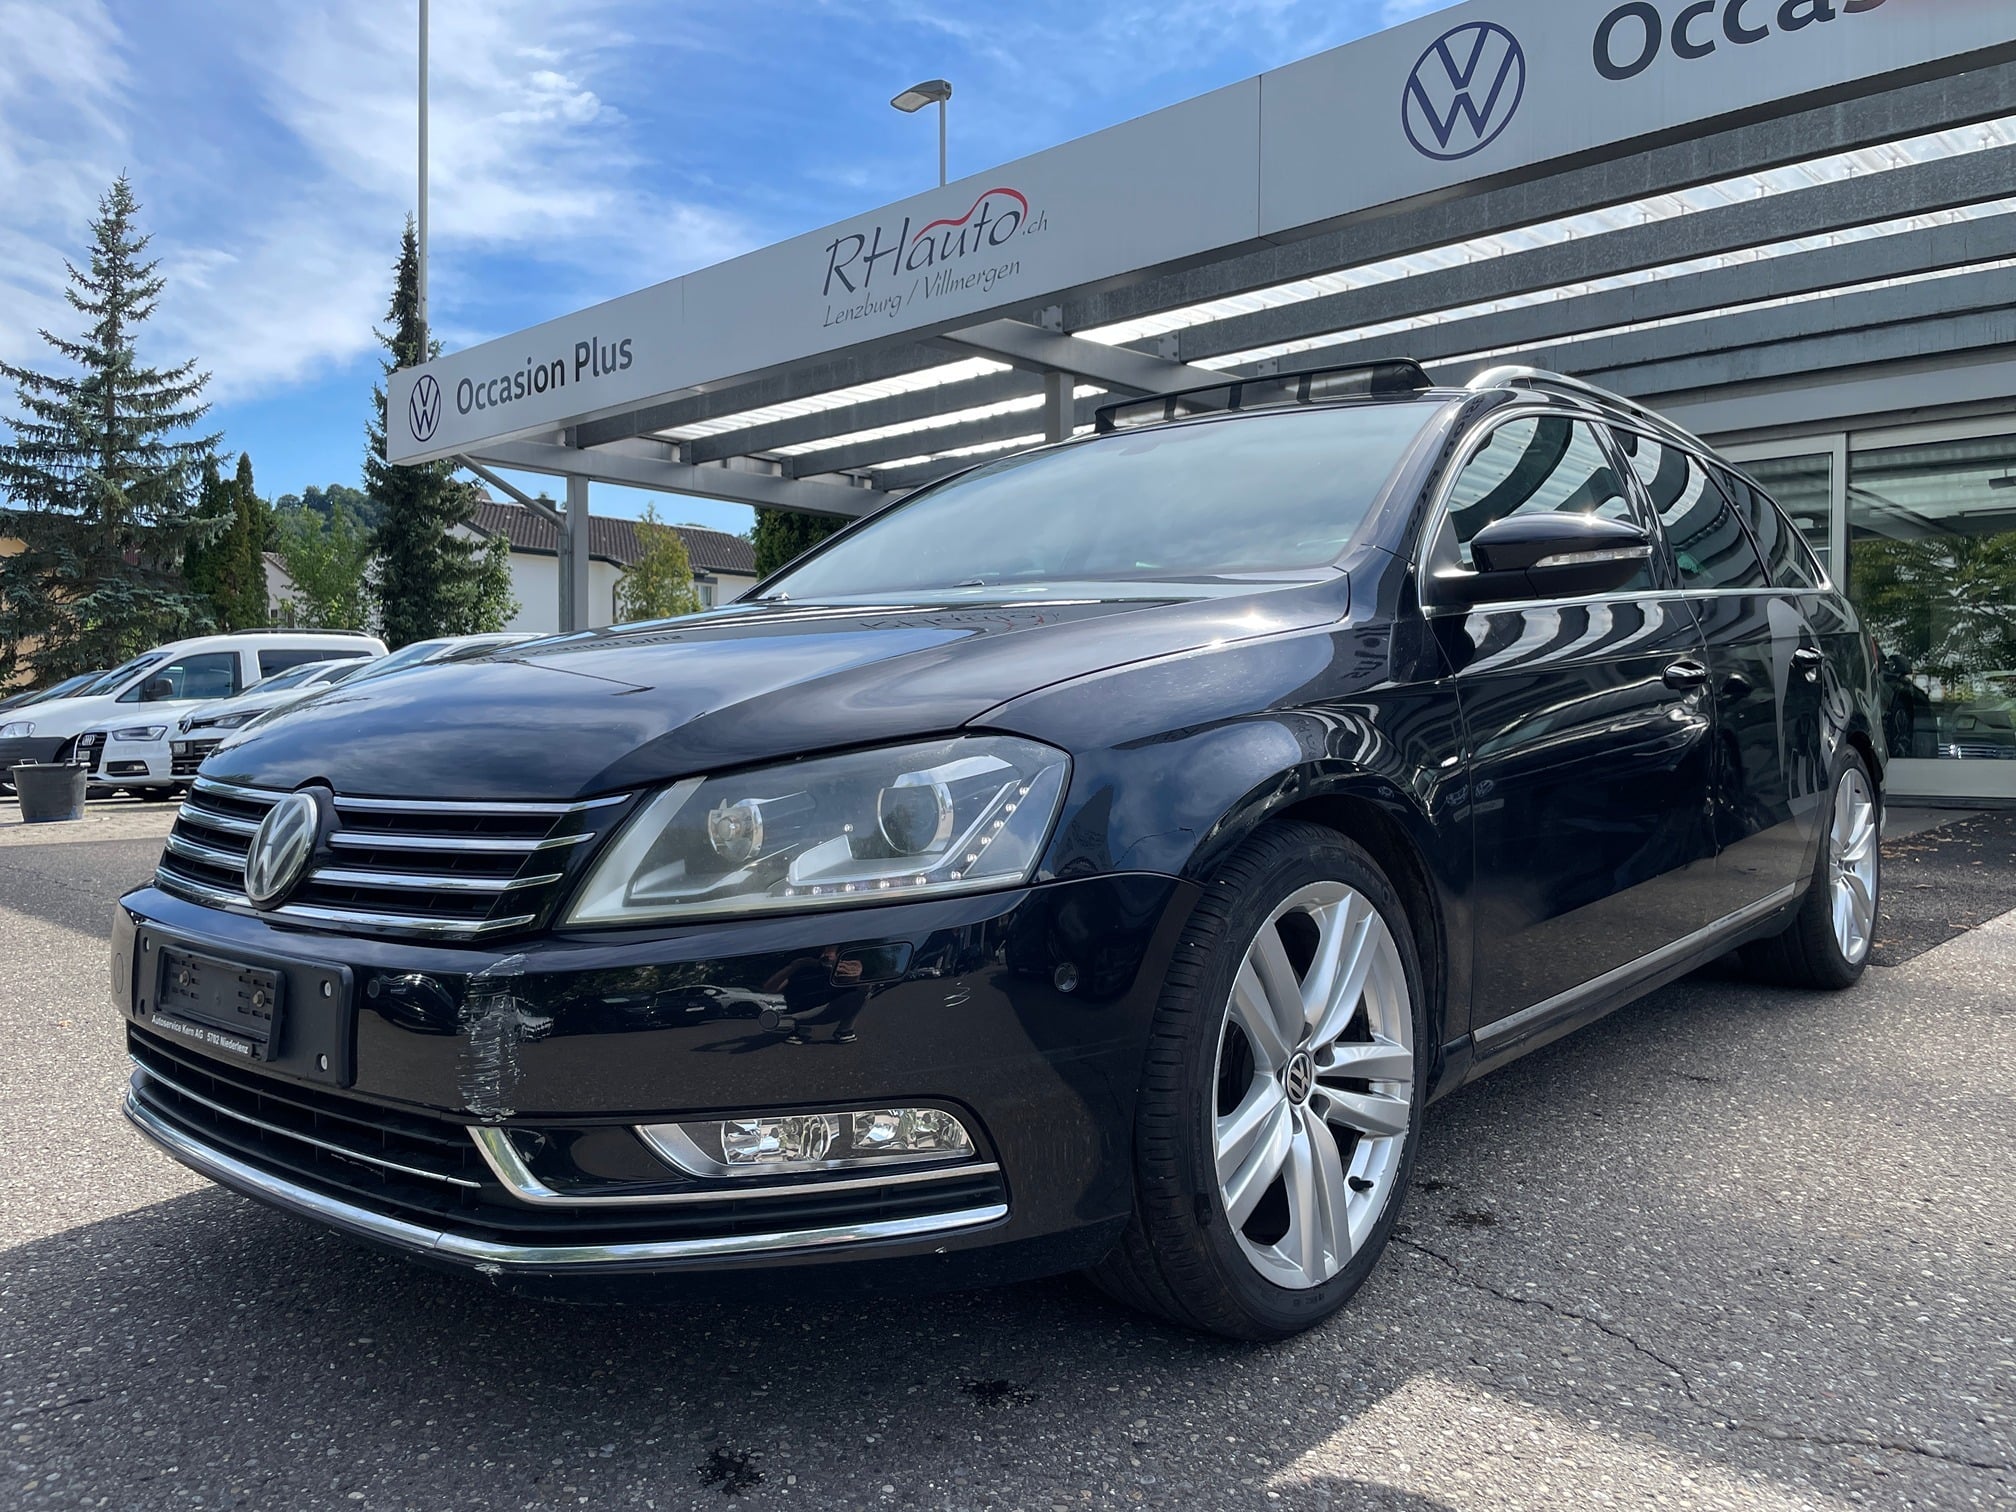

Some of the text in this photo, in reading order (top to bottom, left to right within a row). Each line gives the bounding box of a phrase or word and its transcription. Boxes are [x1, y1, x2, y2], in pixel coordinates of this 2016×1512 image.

[823, 260, 1020, 328] Lenzburg / Villmergen
[456, 336, 633, 415] Occasion Plus
[151, 1014, 182, 1032] Autoservice
[182, 1023, 195, 1037] Kern
[194, 1029, 204, 1040] AG
[220, 1037, 249, 1054] Niederlenz
